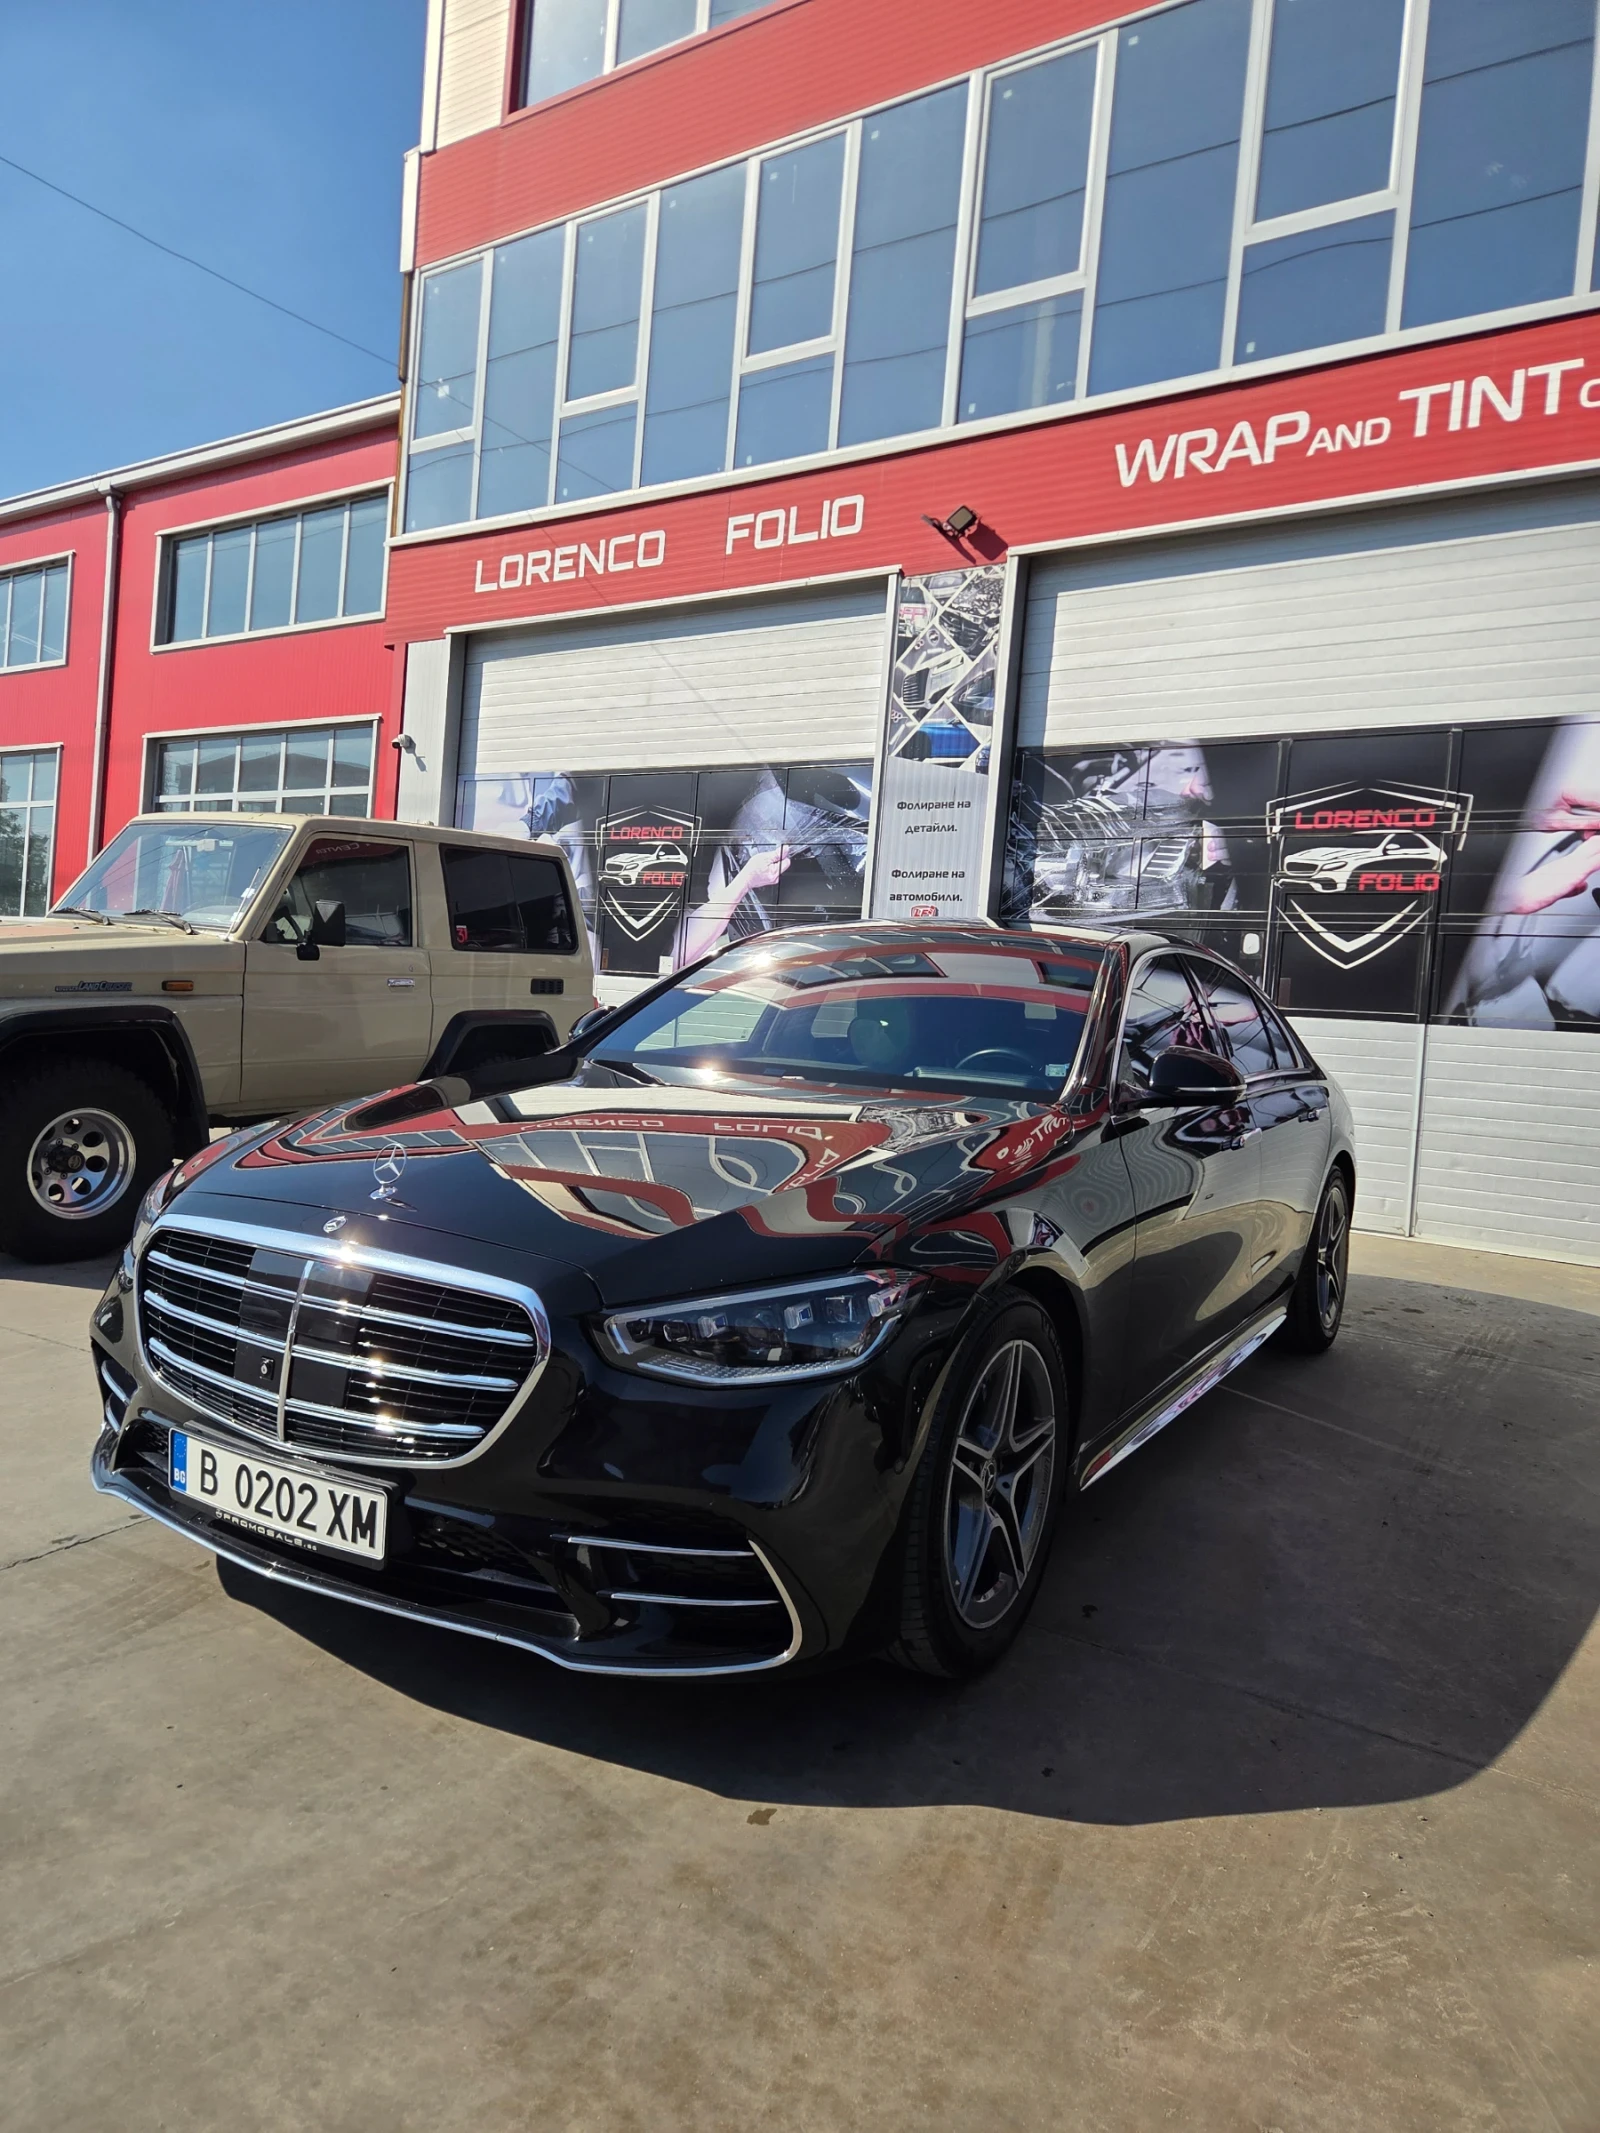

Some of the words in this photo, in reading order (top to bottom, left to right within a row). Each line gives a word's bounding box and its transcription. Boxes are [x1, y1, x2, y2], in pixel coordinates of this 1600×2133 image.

[1114, 410, 1311, 488] WRAP
[1306, 417, 1391, 457] AND
[1399, 358, 1585, 438] TINT
[474, 529, 666, 593] LORENCO
[725, 494, 865, 555] FOLIO
[897, 801, 955, 812] Фолиране
[957, 800, 971, 809] на
[1295, 808, 1436, 830] LORENCO
[610, 826, 683, 840] LORENCO
[904, 822, 958, 835] детайли.
[642, 872, 685, 886] FOLIO
[891, 869, 949, 880] Фолиране
[951, 870, 966, 879] на
[1358, 872, 1441, 891] FOLIO
[889, 891, 963, 902] автомобили.
[173, 1467, 186, 1483] BG
[200, 1448, 218, 1496] B
[235, 1463, 318, 1532] 0202
[326, 1489, 378, 1549] XM
